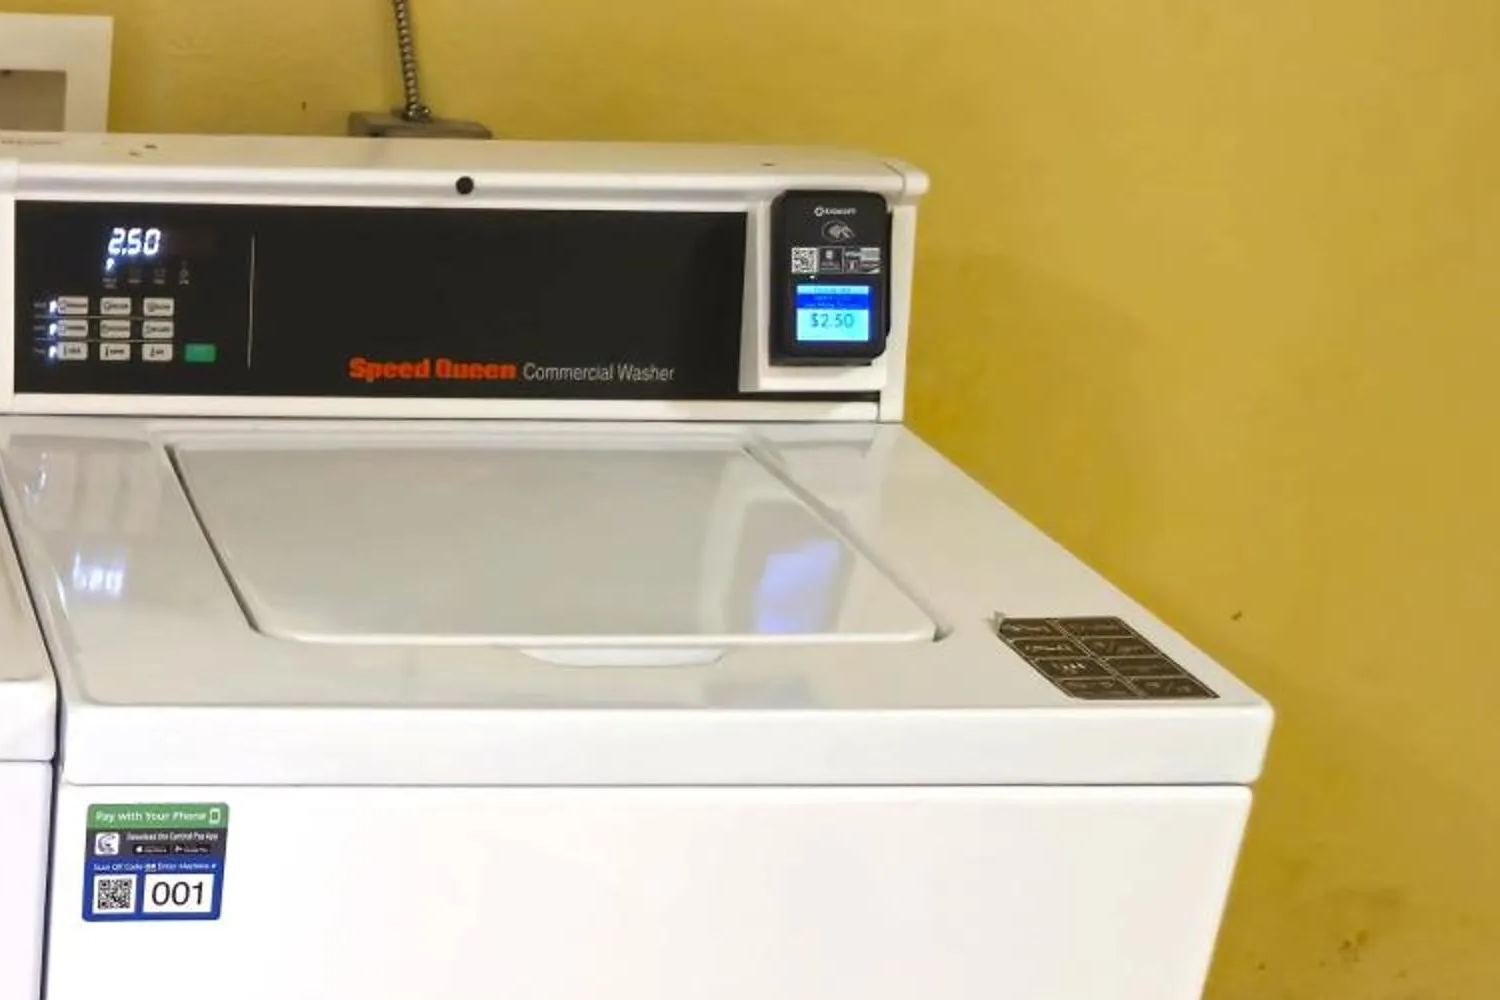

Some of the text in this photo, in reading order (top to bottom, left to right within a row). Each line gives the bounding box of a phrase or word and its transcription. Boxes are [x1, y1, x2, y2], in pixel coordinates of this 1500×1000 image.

[108, 227, 162, 256] 2.50
[811, 313, 855, 329] $2.50
[349, 356, 676, 382] Speed Queen Commercial Washer
[96, 810, 207, 823] Pay with Your Phone
[151, 881, 204, 906] 001
